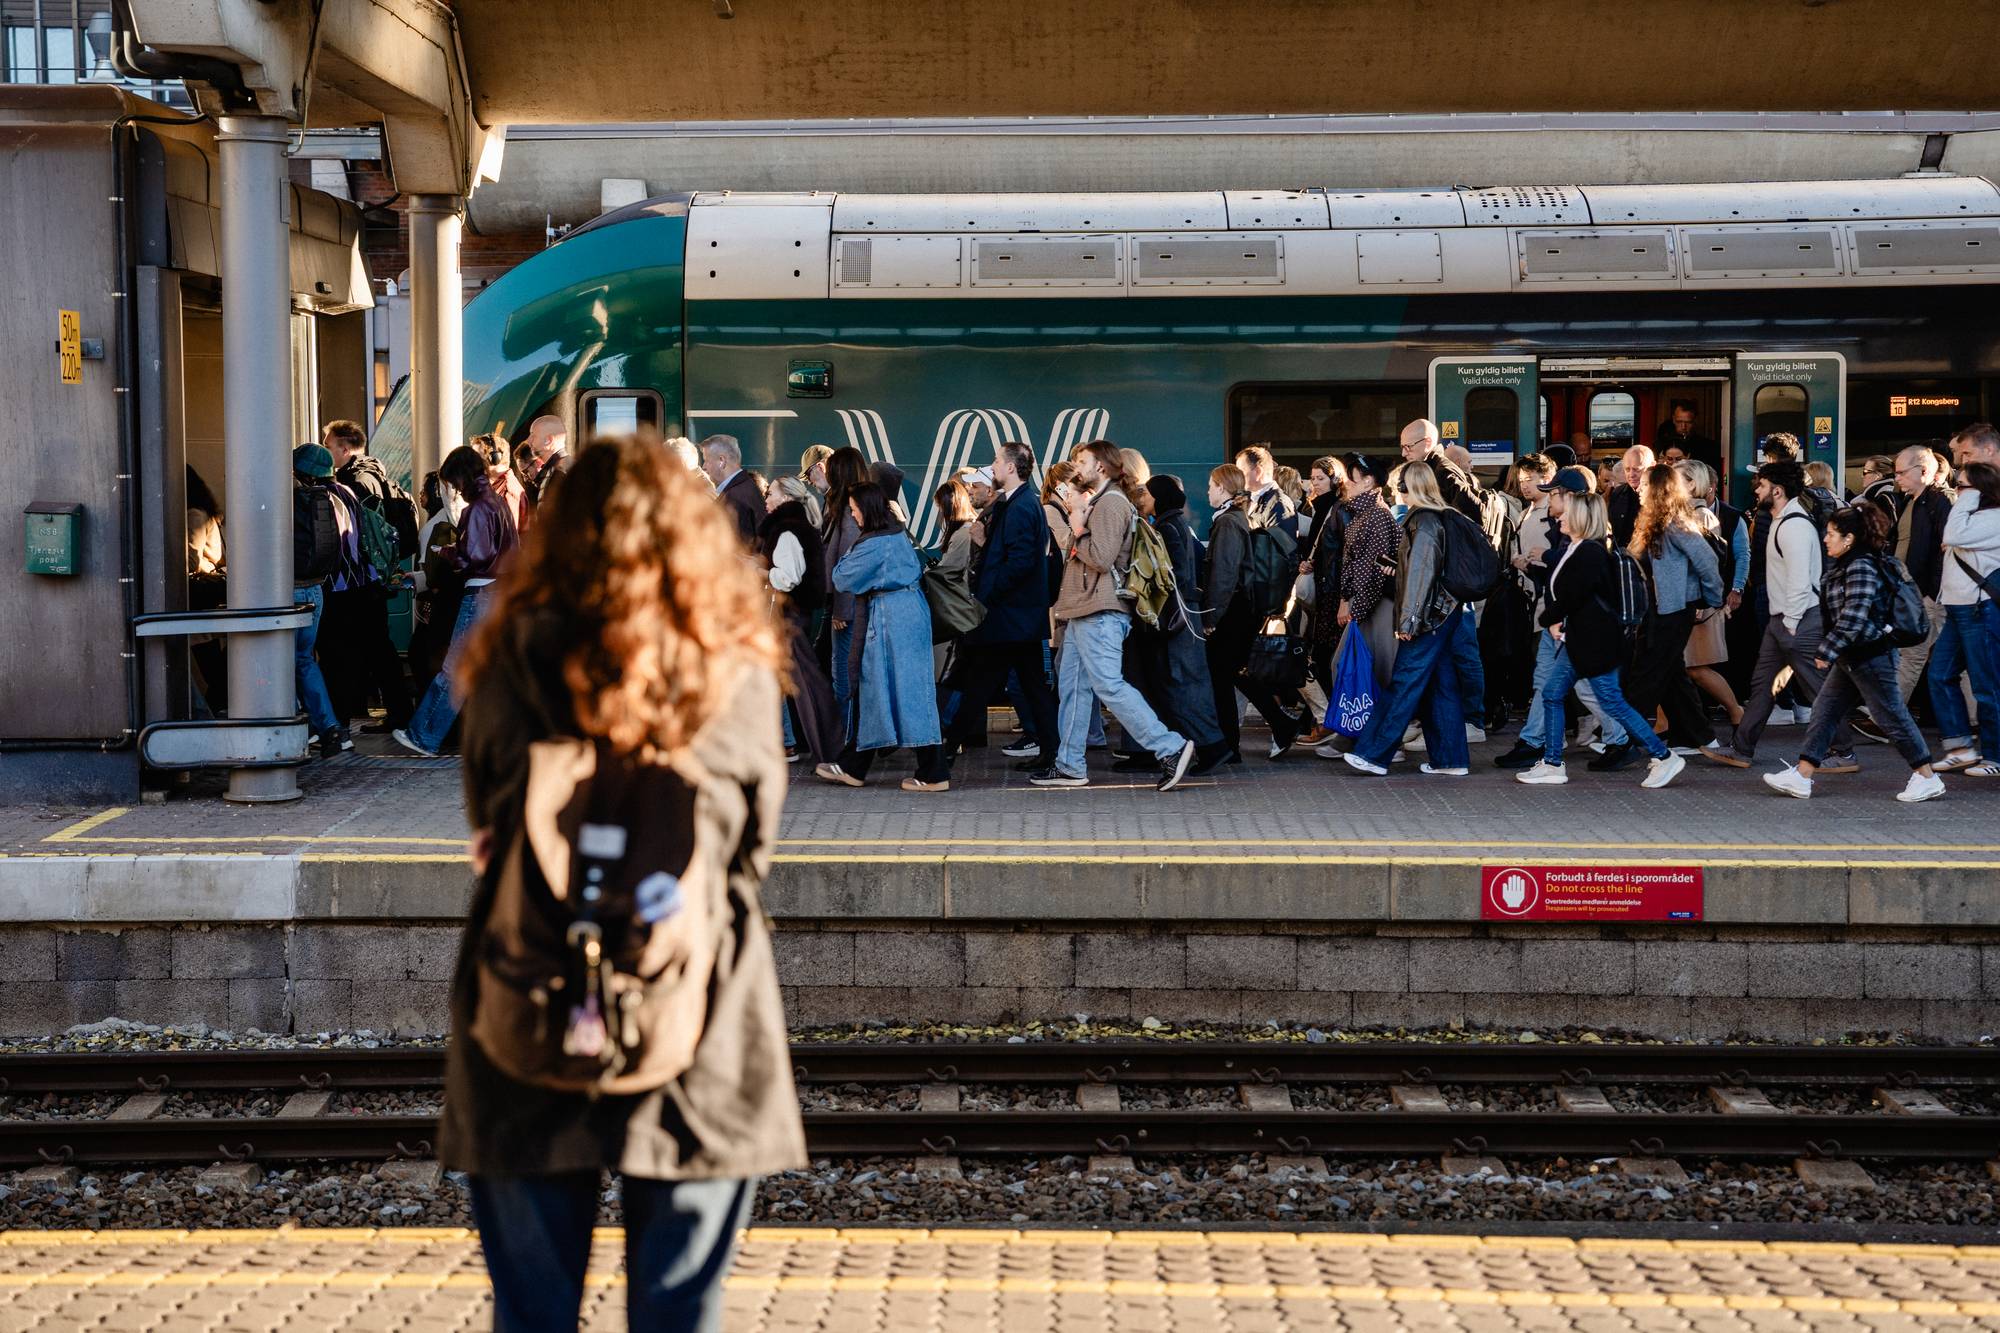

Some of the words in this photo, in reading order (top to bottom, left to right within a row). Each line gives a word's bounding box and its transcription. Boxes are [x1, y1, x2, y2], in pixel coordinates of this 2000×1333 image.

[1475, 366, 1500, 376] gyldig
[1502, 366, 1526, 374] billett
[1747, 363, 1764, 371] Kun
[1766, 362, 1791, 371] gyldig
[1505, 377, 1521, 385] only
[1752, 373, 1771, 381] Valid
[1796, 373, 1812, 381] only
[1922, 398, 1959, 406] Kongsberg
[1894, 406, 1903, 415] 10
[39, 527, 57, 536] NSB
[1545, 872, 1585, 882] Forbudt
[1586, 872, 1592, 882] å
[1594, 873, 1624, 882] ferdes
[1631, 873, 1694, 884] sporområdet
[1546, 884, 1560, 893] Do
[1562, 885, 1578, 893] not
[1607, 885, 1623, 893] the
[1625, 885, 1643, 893] line
